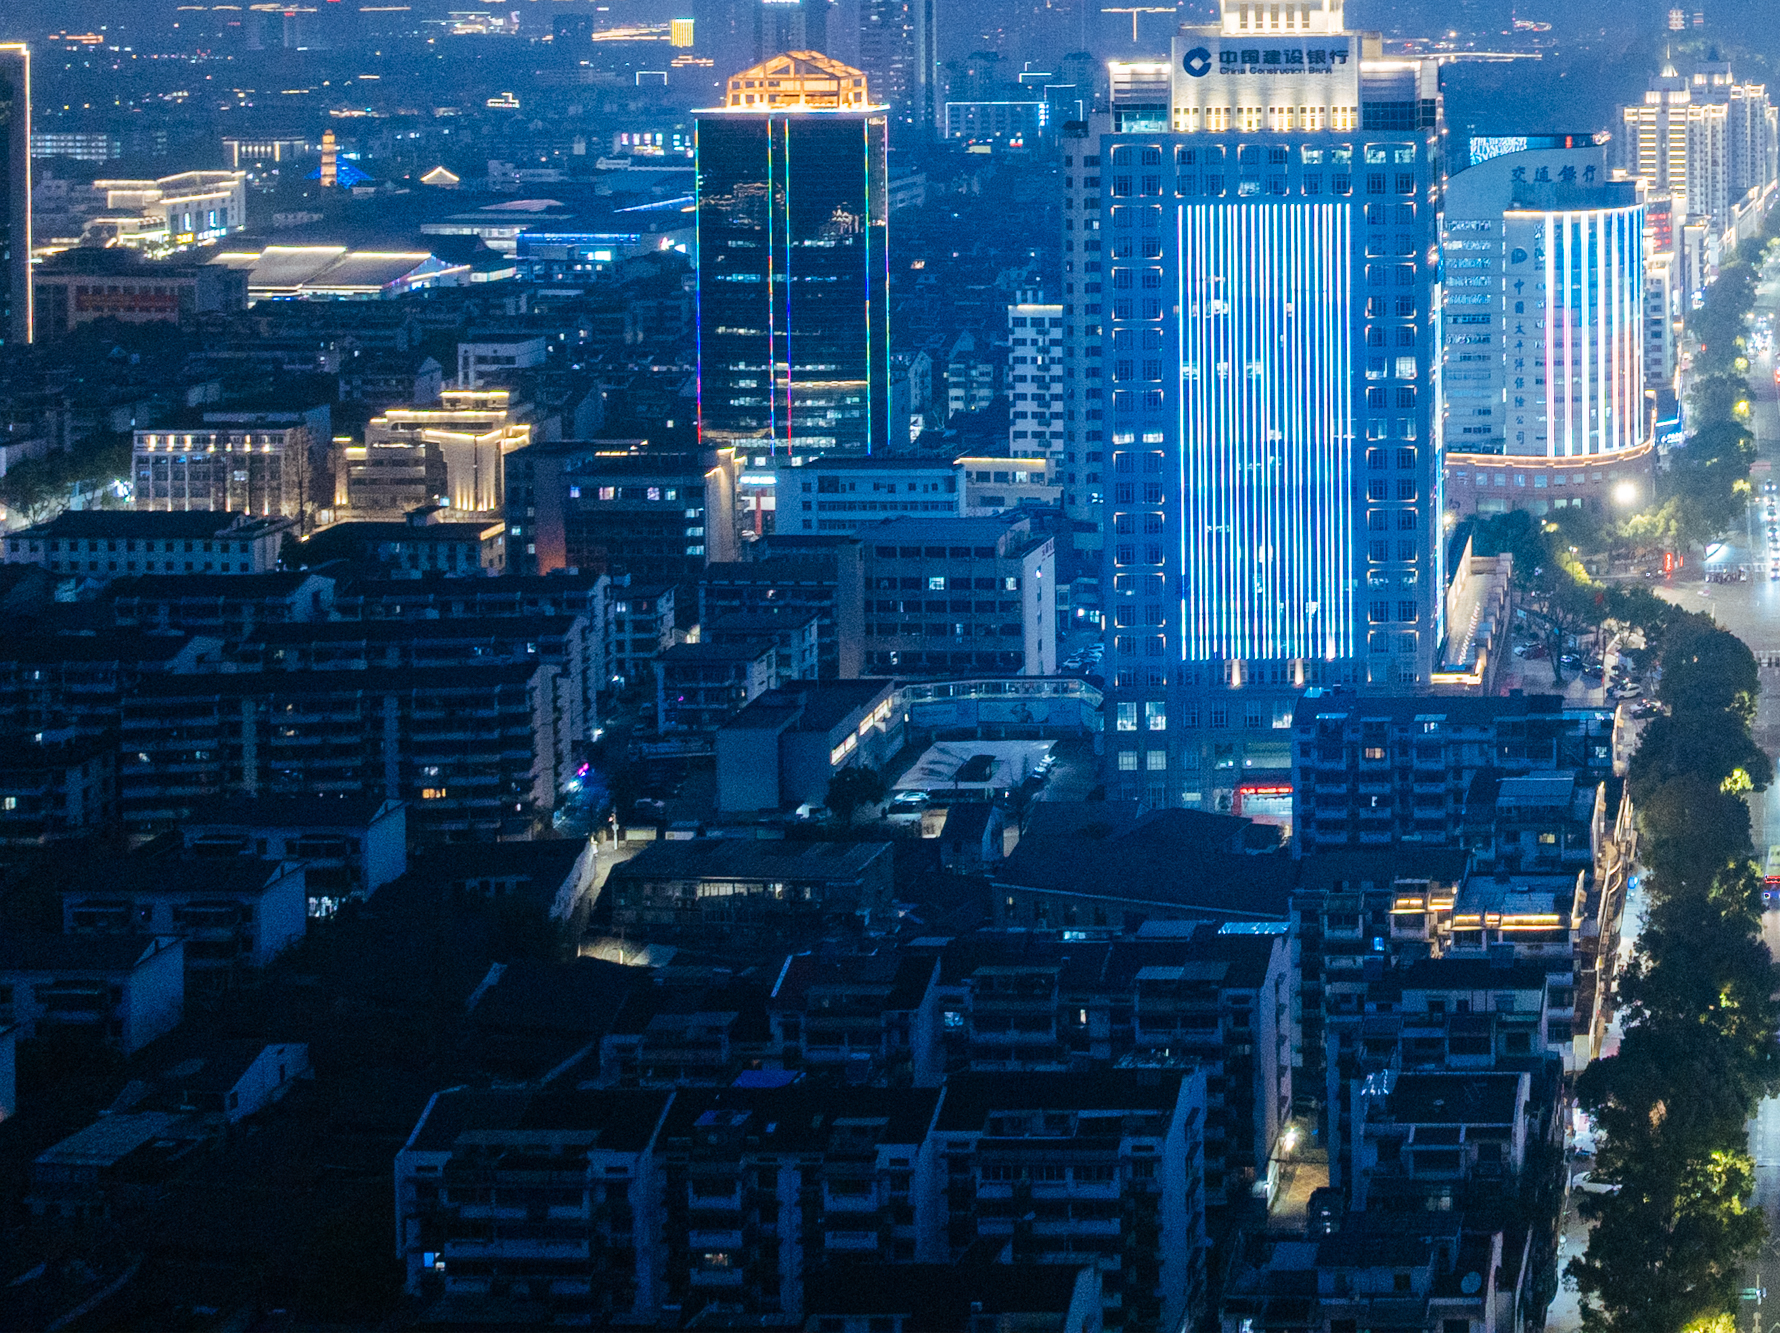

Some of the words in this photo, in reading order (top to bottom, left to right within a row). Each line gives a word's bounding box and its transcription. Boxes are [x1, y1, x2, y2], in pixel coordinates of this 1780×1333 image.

[1219, 49, 1349, 65] 中国建设银行
[1219, 67, 1246, 75] China
[1250, 67, 1305, 75] Construction
[1309, 67, 1333, 75] Bank
